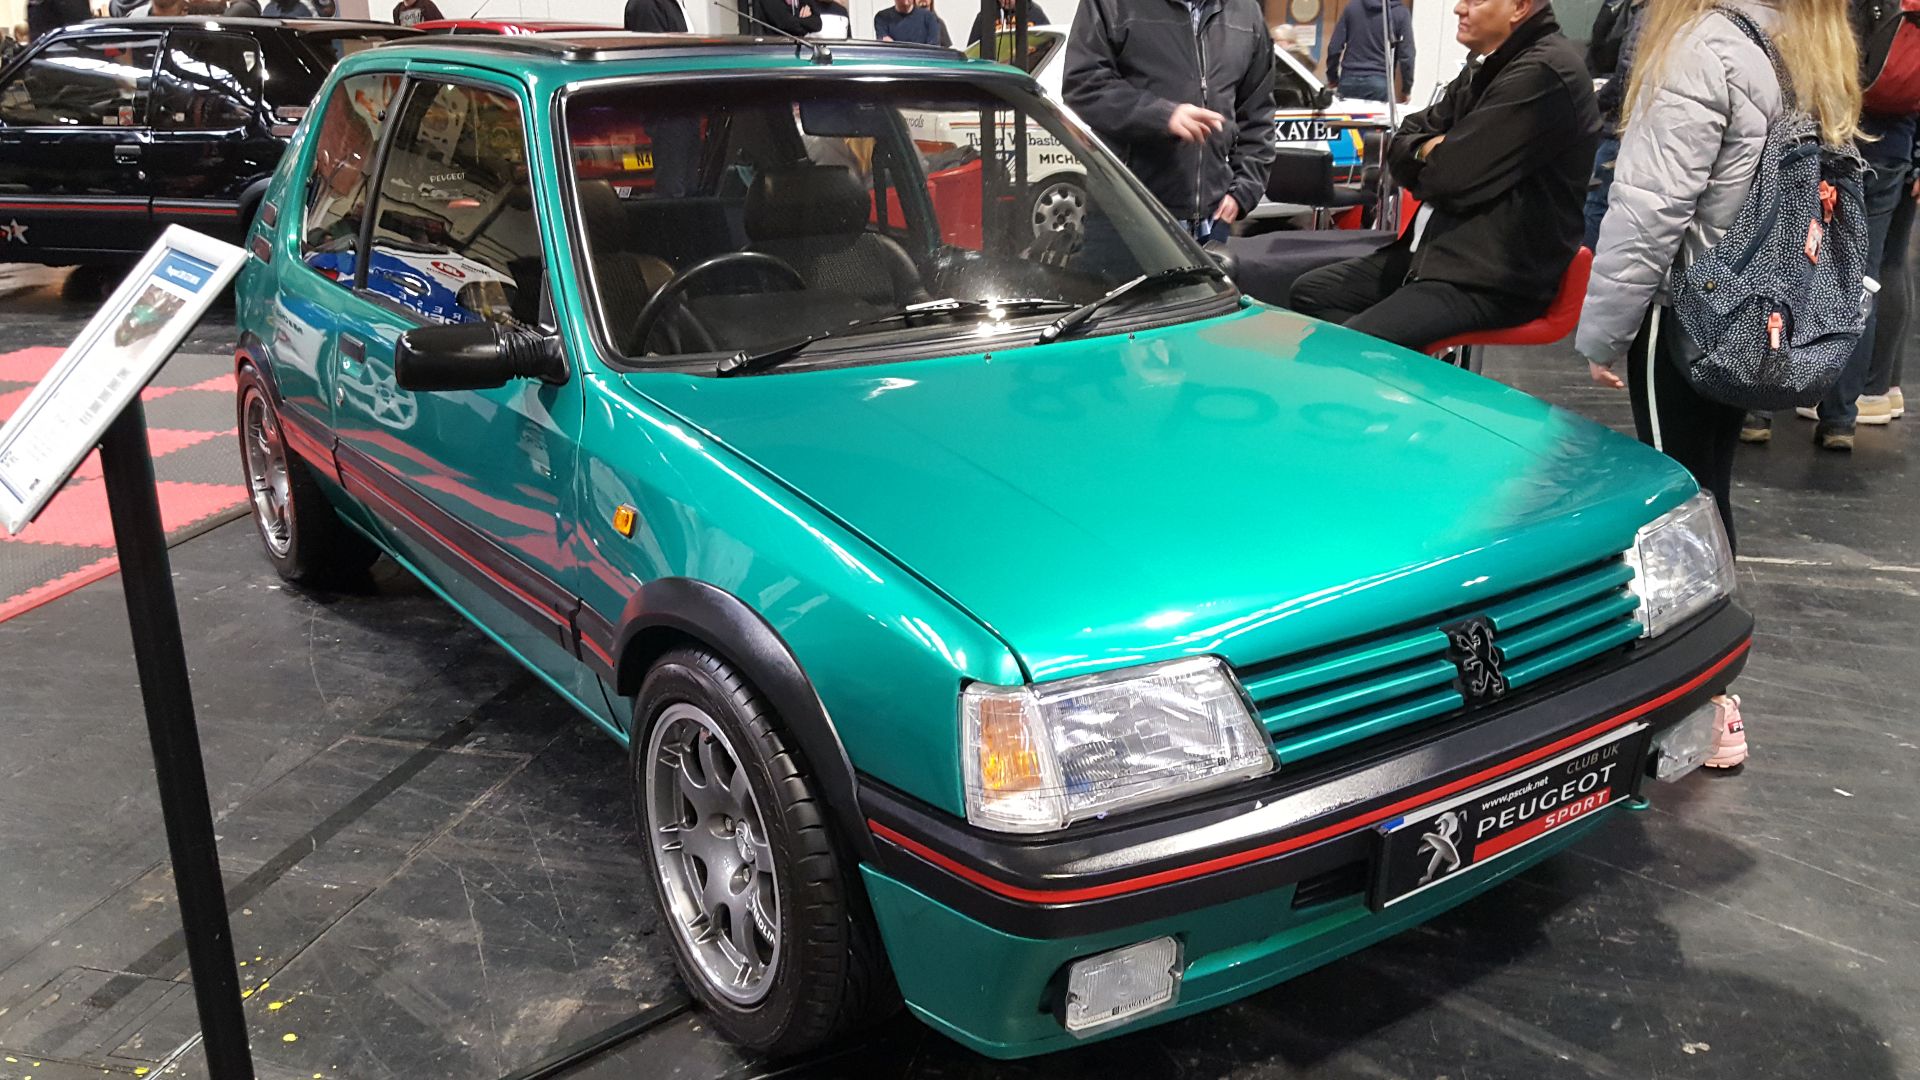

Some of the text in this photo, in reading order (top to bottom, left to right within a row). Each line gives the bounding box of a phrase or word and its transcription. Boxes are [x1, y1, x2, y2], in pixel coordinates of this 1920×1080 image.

[429, 172, 465, 183] PEUGEOT
[1566, 743, 1620, 775] CLUB UK
[1476, 762, 1617, 839] PEUGEOT
[1481, 776, 1549, 811] www.pscuk.net
[1544, 790, 1608, 829] SPORT
